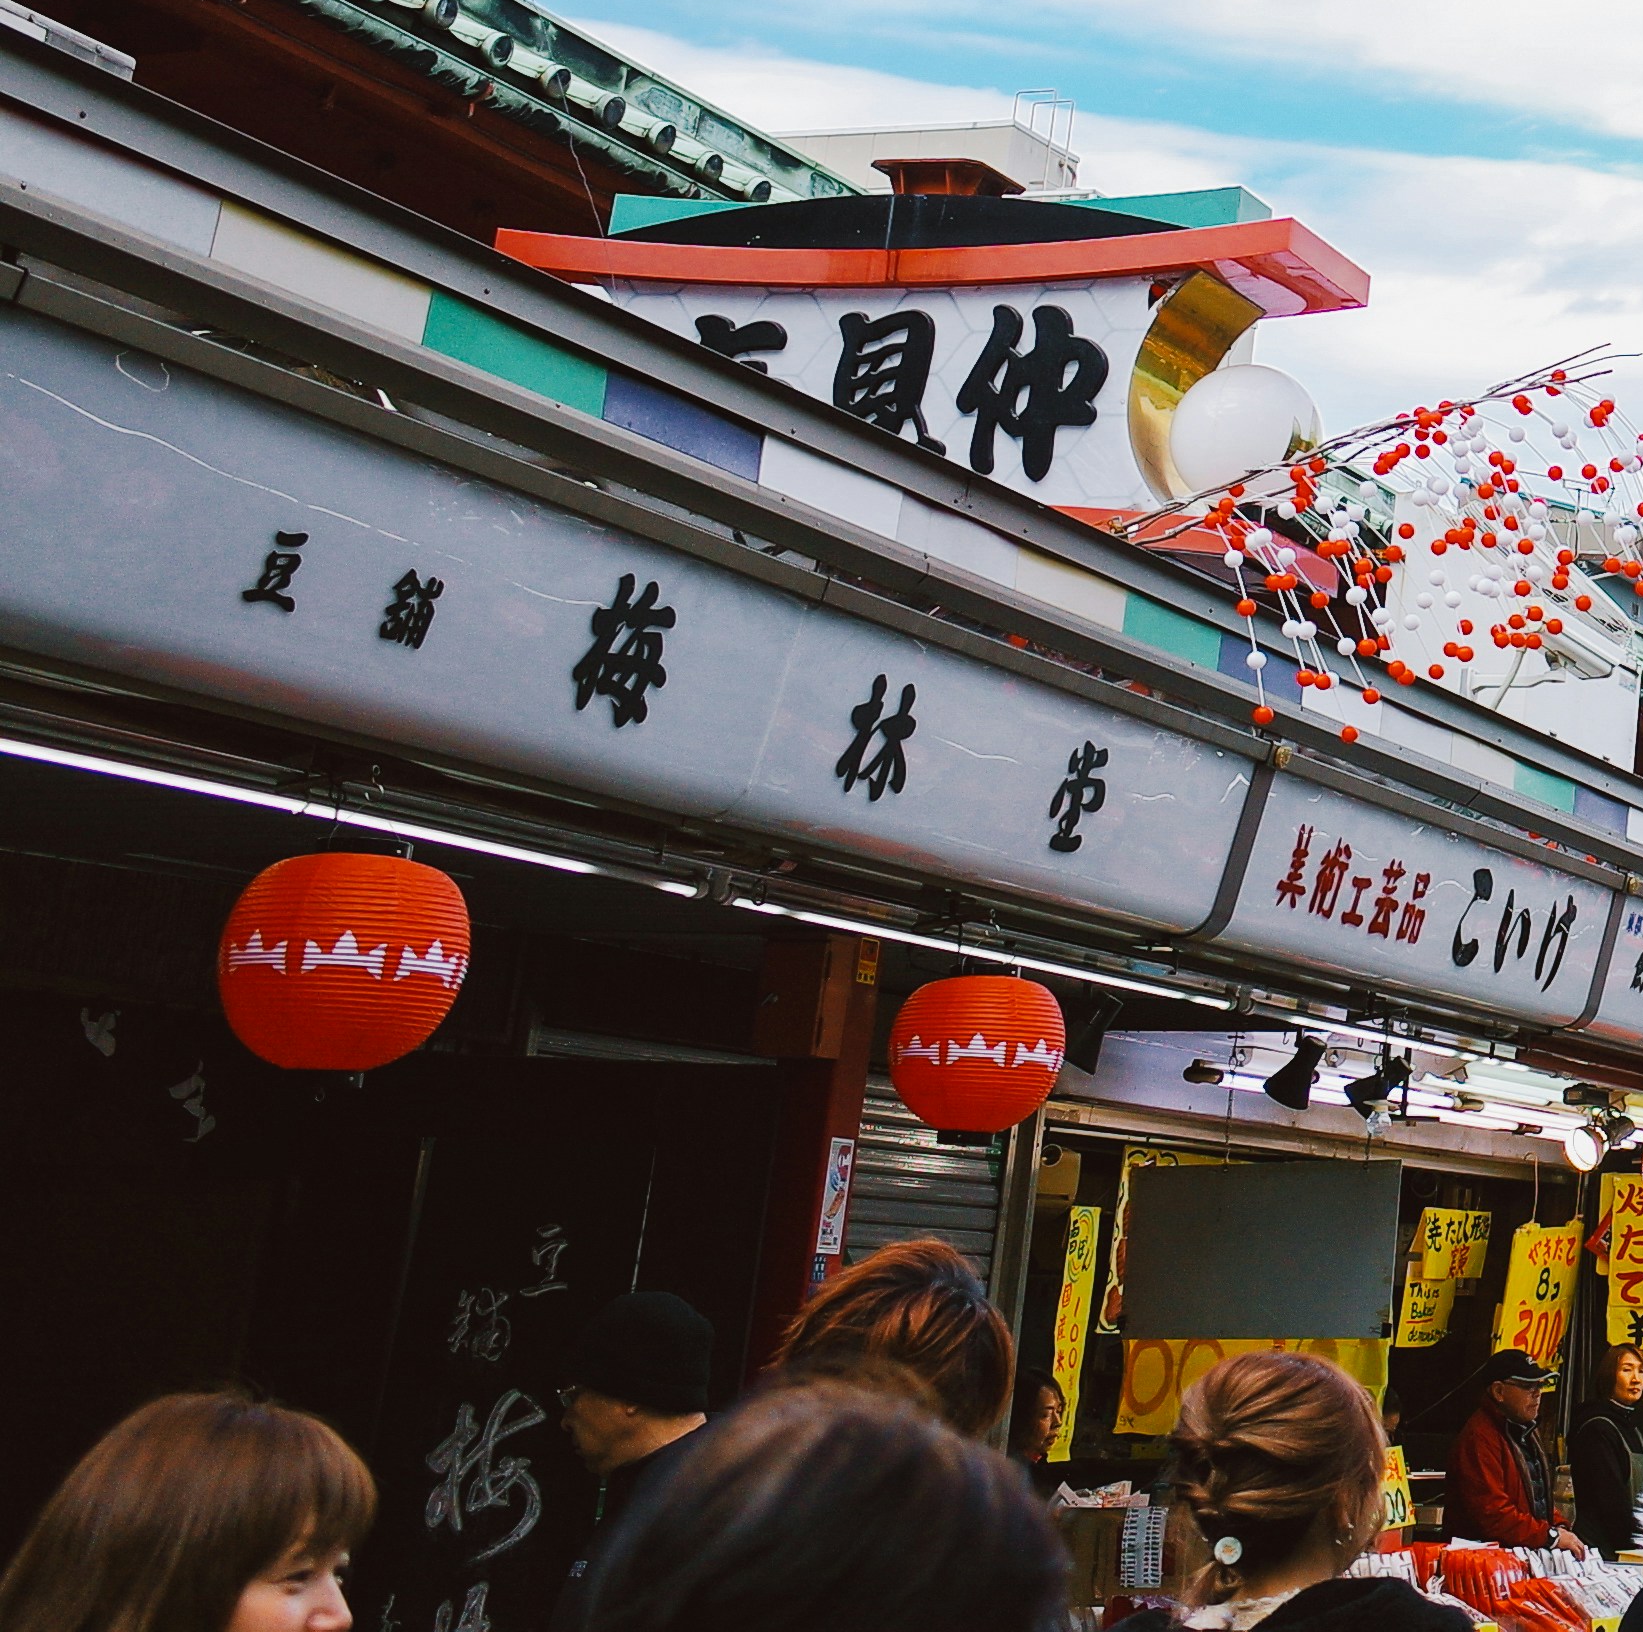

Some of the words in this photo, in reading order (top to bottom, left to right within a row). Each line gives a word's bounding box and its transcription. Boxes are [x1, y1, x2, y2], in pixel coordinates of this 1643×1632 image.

[1276, 824, 1430, 945] 美術工芸品
[1453, 868, 1578, 993] こいけ
[1528, 1235, 1577, 1266] やきたて
